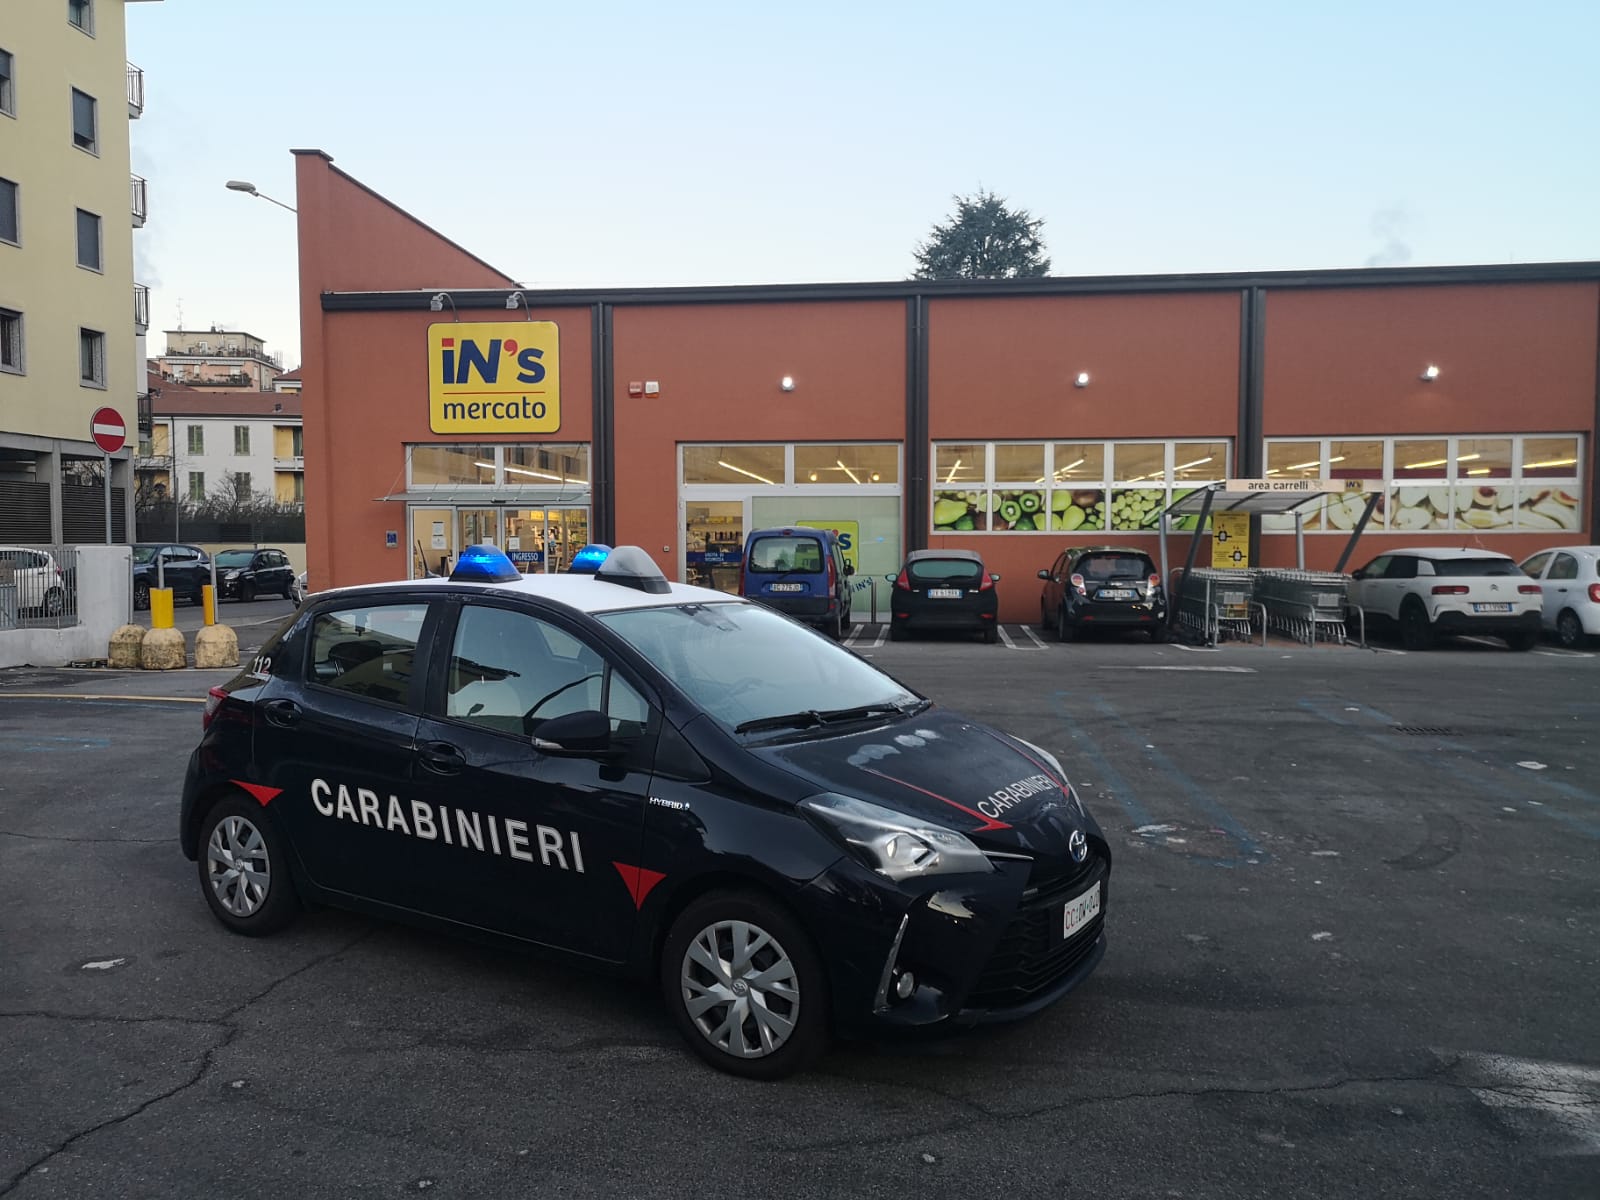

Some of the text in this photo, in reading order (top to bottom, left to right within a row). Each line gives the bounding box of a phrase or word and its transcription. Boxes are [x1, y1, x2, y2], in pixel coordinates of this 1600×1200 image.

[443, 396, 547, 420] mercato
[1248, 480, 1308, 490] area carrelli
[511, 552, 539, 561] INGRESSO
[252, 655, 272, 675] 112
[649, 796, 684, 810] HYBRID
[977, 774, 1060, 819] CARABINIERI
[310, 777, 586, 874] CARABINIERI
